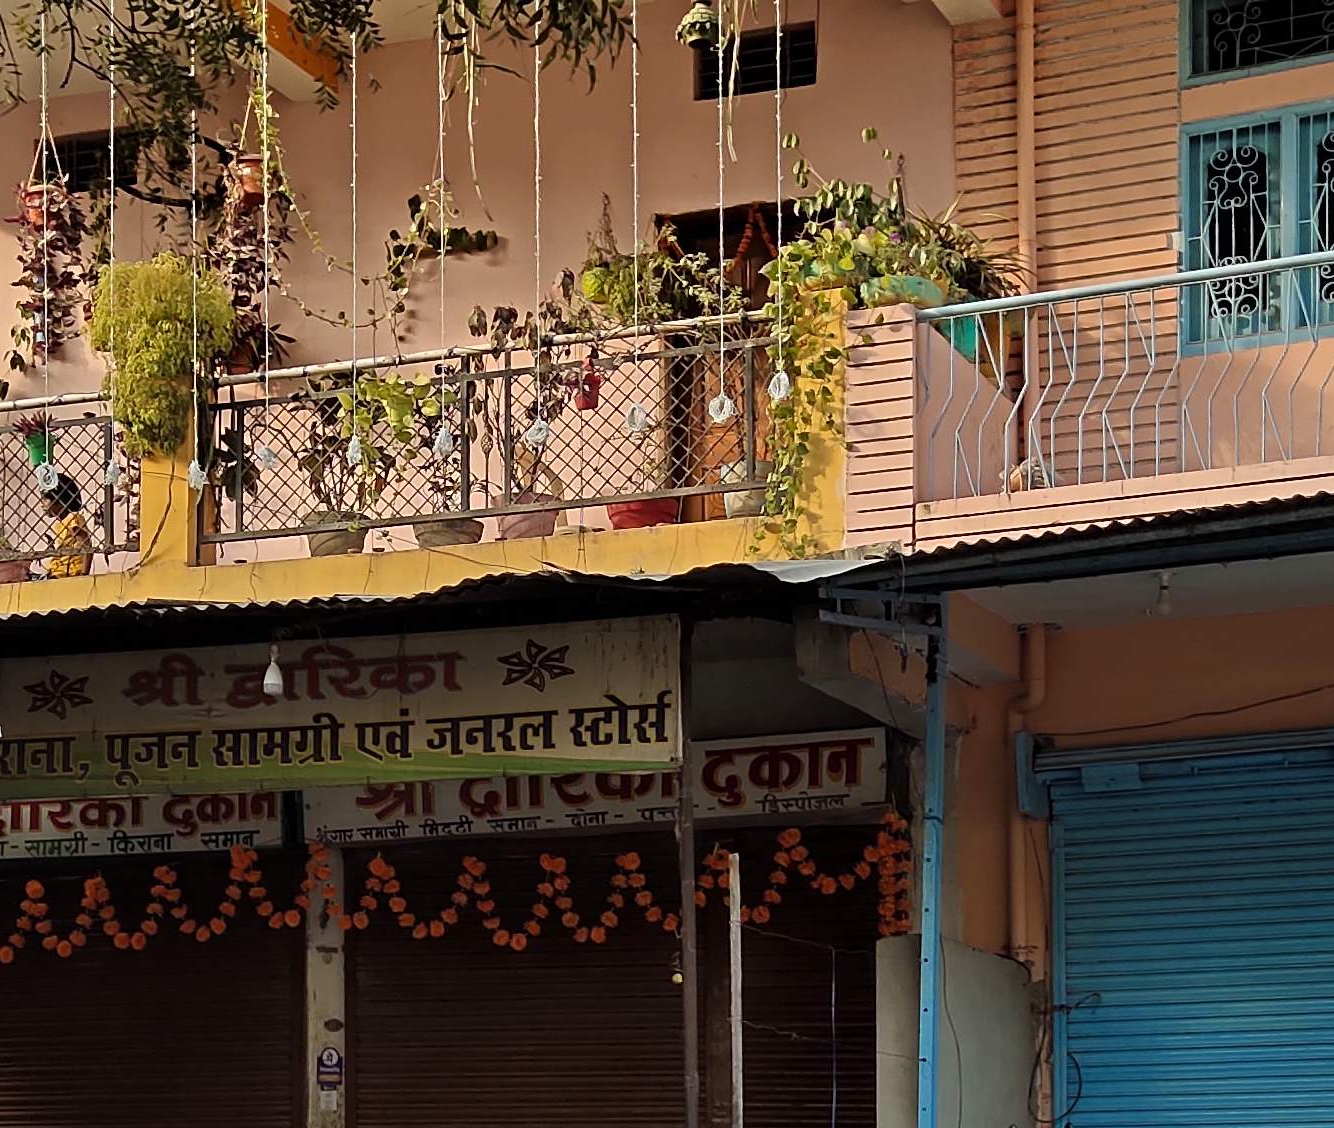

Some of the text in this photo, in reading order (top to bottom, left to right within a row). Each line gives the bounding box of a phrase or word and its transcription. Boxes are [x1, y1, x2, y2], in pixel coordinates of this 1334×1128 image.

[122, 653, 204, 707] श्री
[104, 731, 202, 787] पूजन
[212, 713, 345, 766] सामग्री
[355, 708, 415, 762] एवं
[426, 710, 558, 755] जनरल
[570, 690, 672, 747] स्टोर्स
[702, 737, 875, 808] दुकान
